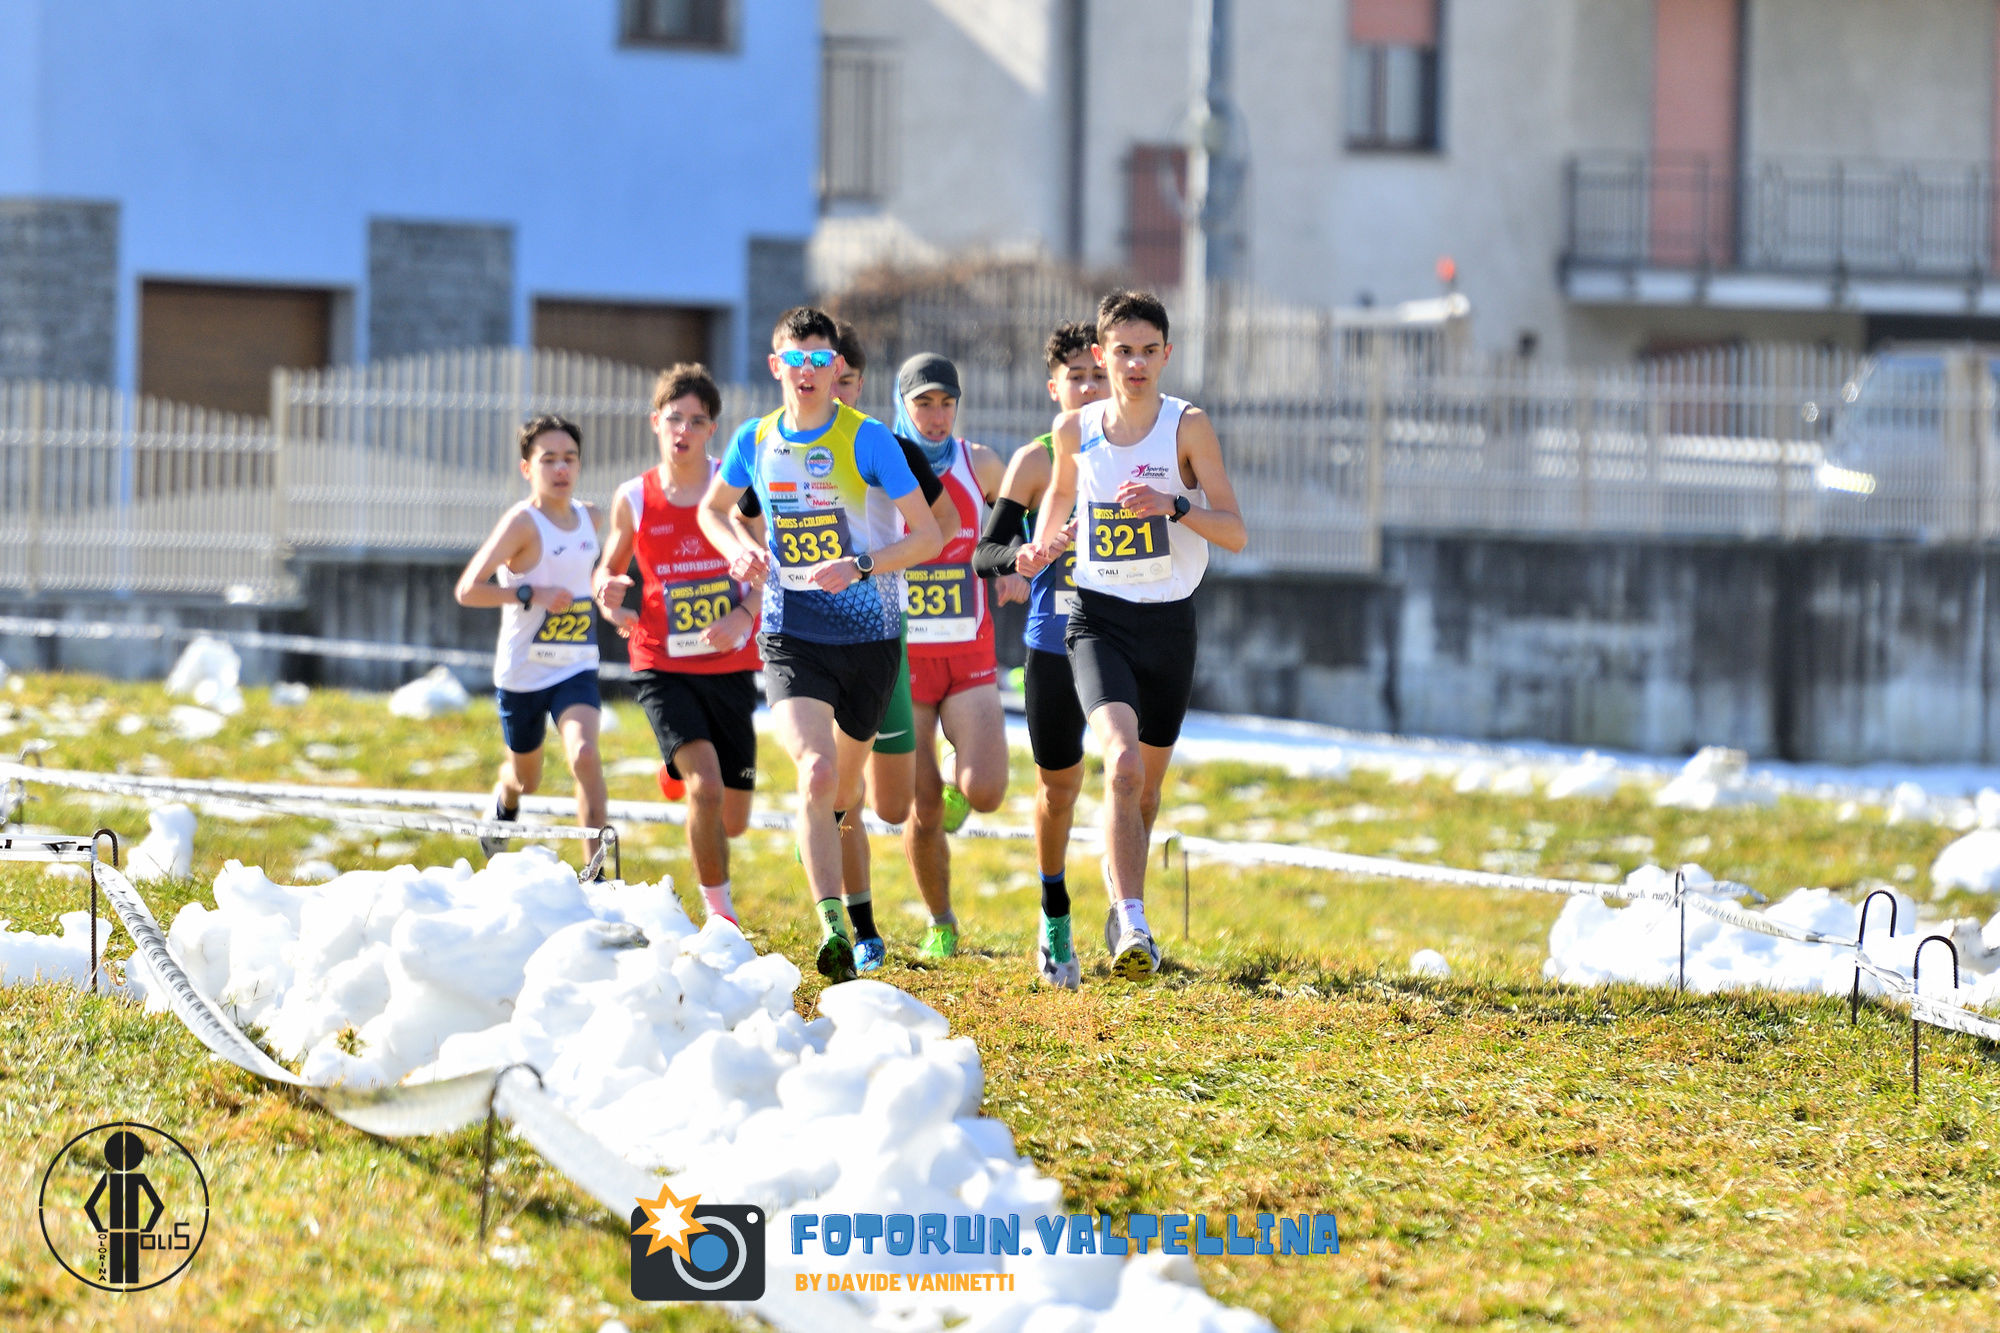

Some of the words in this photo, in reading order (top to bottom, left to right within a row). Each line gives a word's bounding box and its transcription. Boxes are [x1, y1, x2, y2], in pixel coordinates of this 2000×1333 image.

[776, 517, 798, 529] CROSS
[803, 514, 838, 528] COLORINA
[1093, 508, 1114, 520] CROSS
[782, 529, 843, 564] 333
[1095, 521, 1154, 557] 321
[904, 570, 928, 582] CROSS
[934, 568, 966, 580] COLORINA
[670, 586, 694, 600] CROSS
[699, 580, 731, 596] COLORINA
[907, 583, 962, 616] 331
[674, 595, 732, 631] 330
[540, 614, 591, 642] 322
